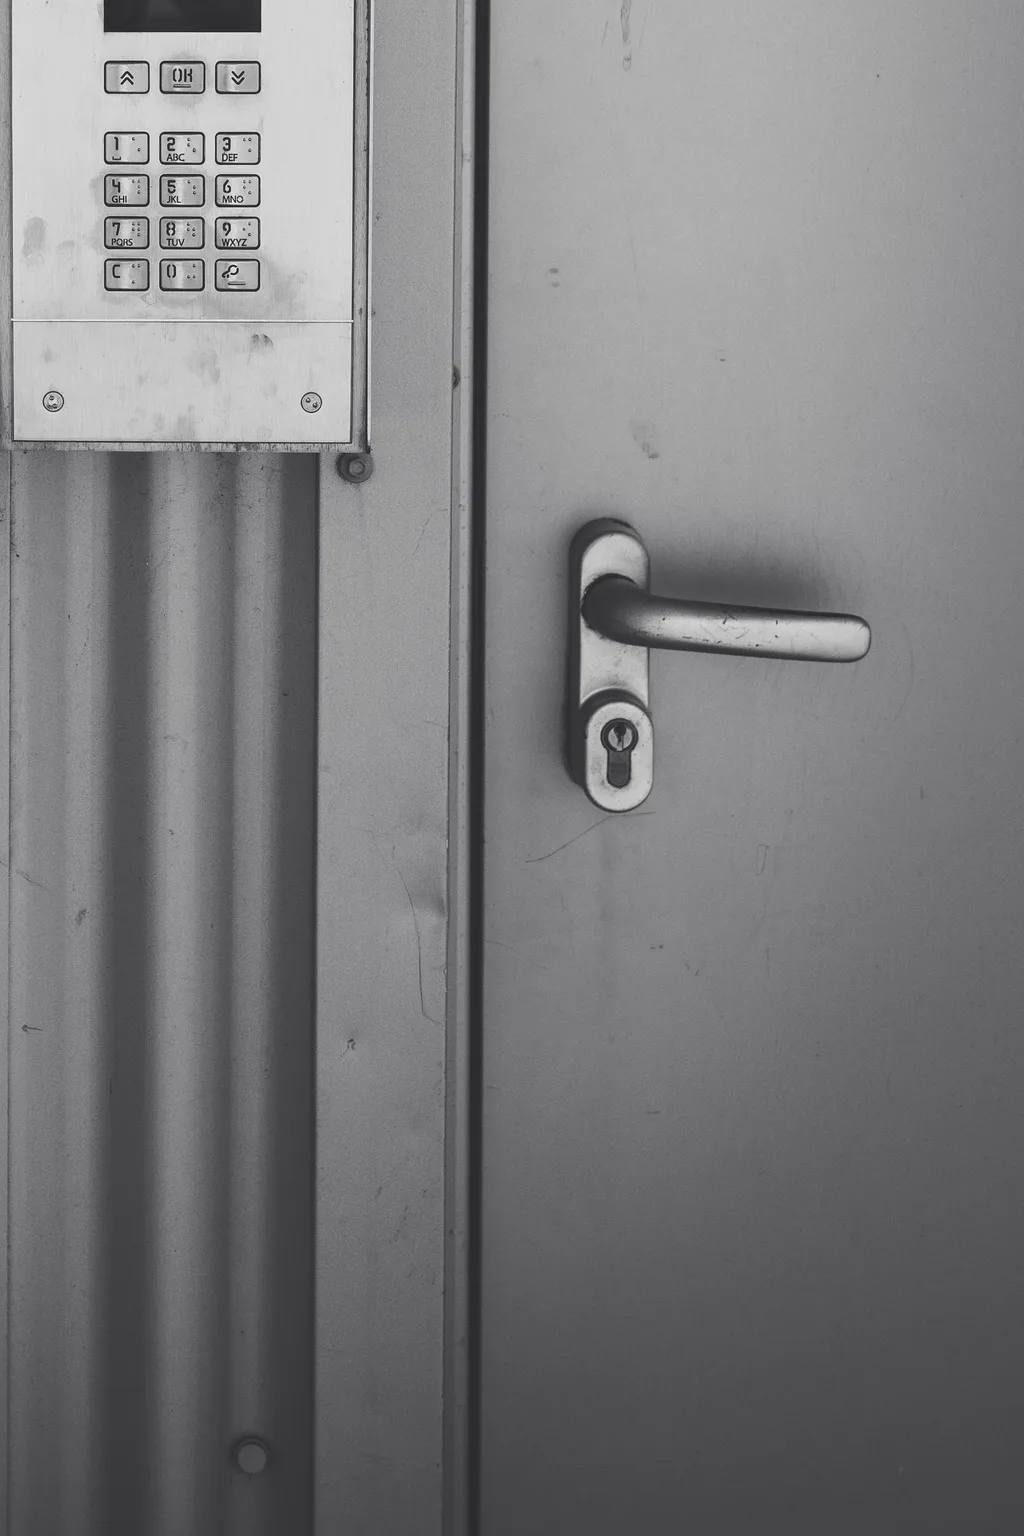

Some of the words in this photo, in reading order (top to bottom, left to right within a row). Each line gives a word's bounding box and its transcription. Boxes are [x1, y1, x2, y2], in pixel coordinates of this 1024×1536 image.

[172, 68, 193, 83] OK
[114, 137, 119, 151] 1
[166, 137, 176, 151] 2
[222, 137, 232, 152] 3
[166, 153, 185, 162] ABC
[222, 153, 238, 162] DEF
[112, 179, 121, 193] 4
[167, 179, 176, 194] 5
[223, 179, 232, 194] 6
[111, 195, 128, 204] GHI
[166, 195, 181, 204] JKL
[222, 195, 244, 204] MNO
[112, 222, 121, 236] 7
[166, 221, 176, 236] 8
[222, 222, 232, 236] 9
[111, 238, 133, 248] PQRS
[166, 238, 185, 247] TUV
[222, 238, 247, 247] WXYZ
[112, 264, 121, 279] C
